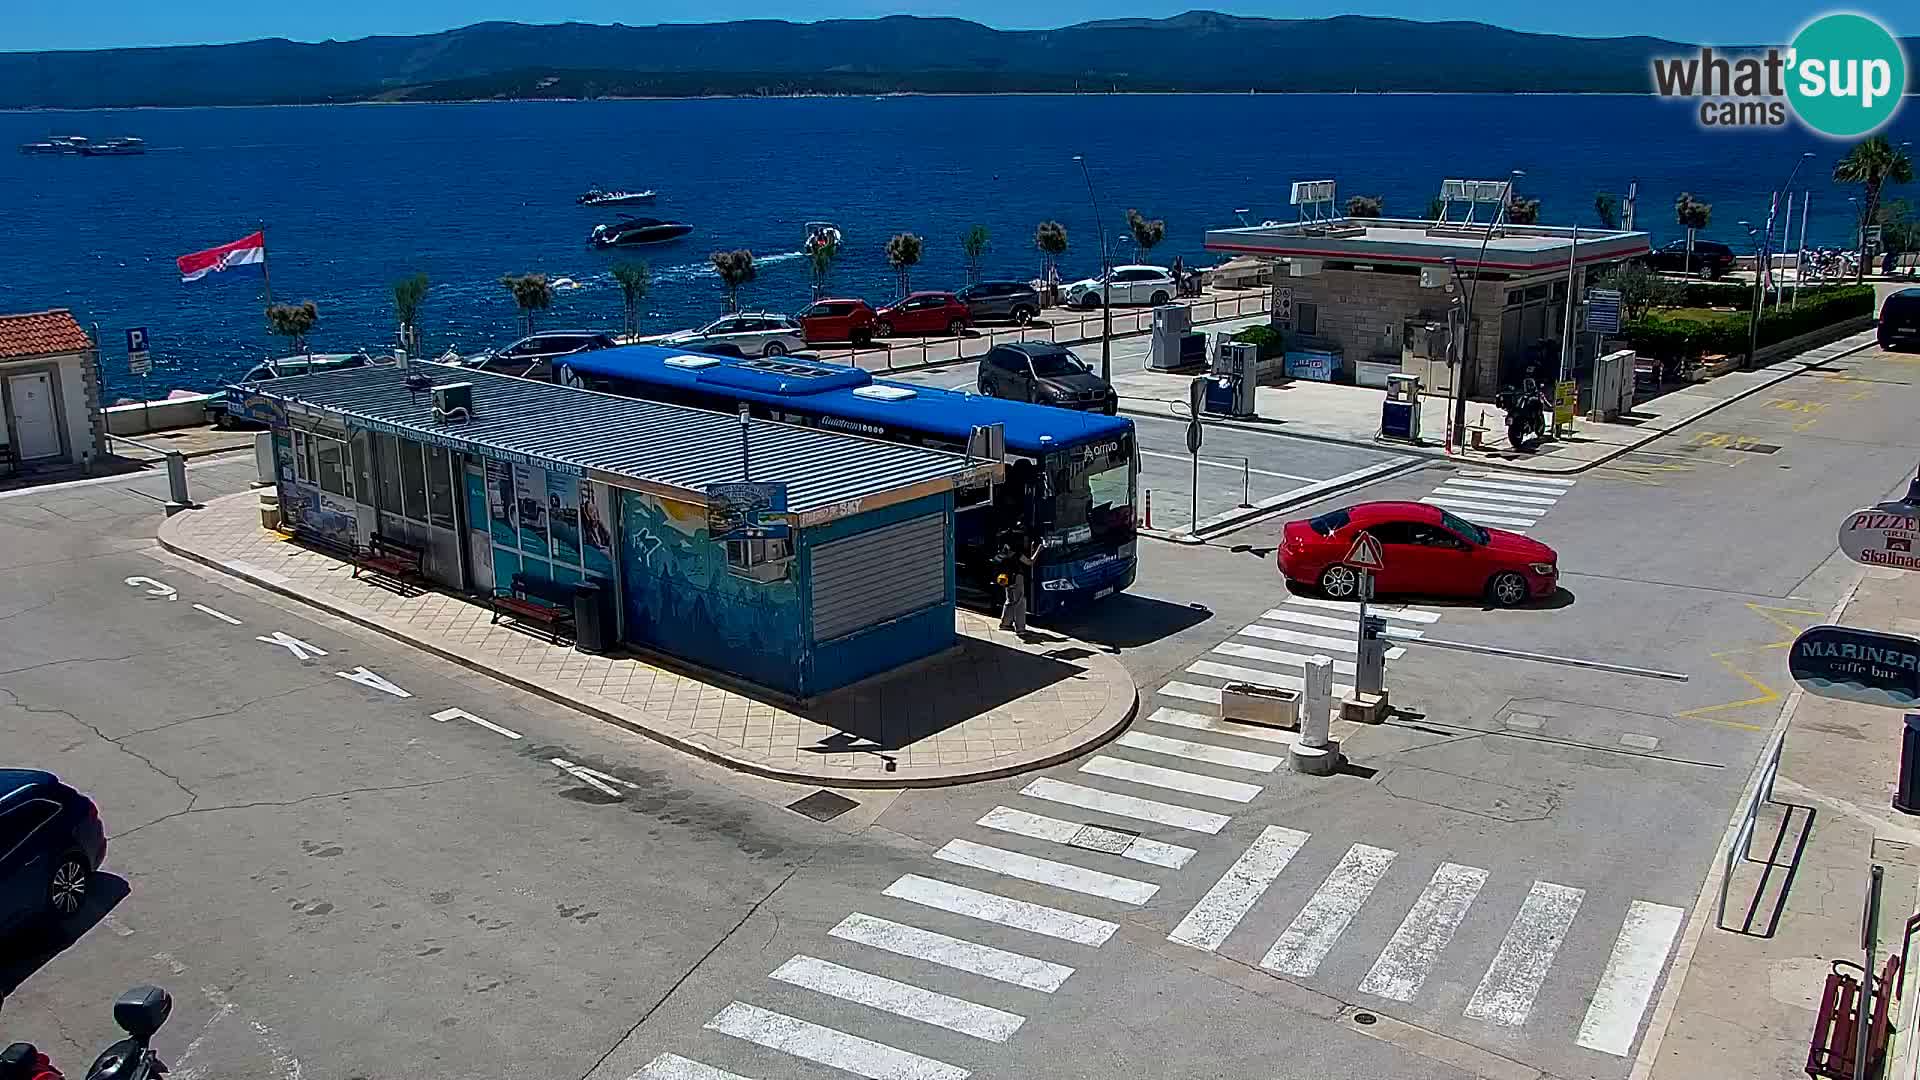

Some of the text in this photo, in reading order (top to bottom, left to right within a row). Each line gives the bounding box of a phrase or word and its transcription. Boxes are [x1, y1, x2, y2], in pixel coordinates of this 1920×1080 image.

[131, 331, 142, 348] P
[495, 449, 527, 464] STATION
[530, 457, 555, 470] TICKET
[556, 461, 583, 476] OFFICE
[1849, 514, 1920, 532] PIZZE
[1802, 642, 1920, 673] MARINER
[1829, 661, 1897, 679] caffe bar
